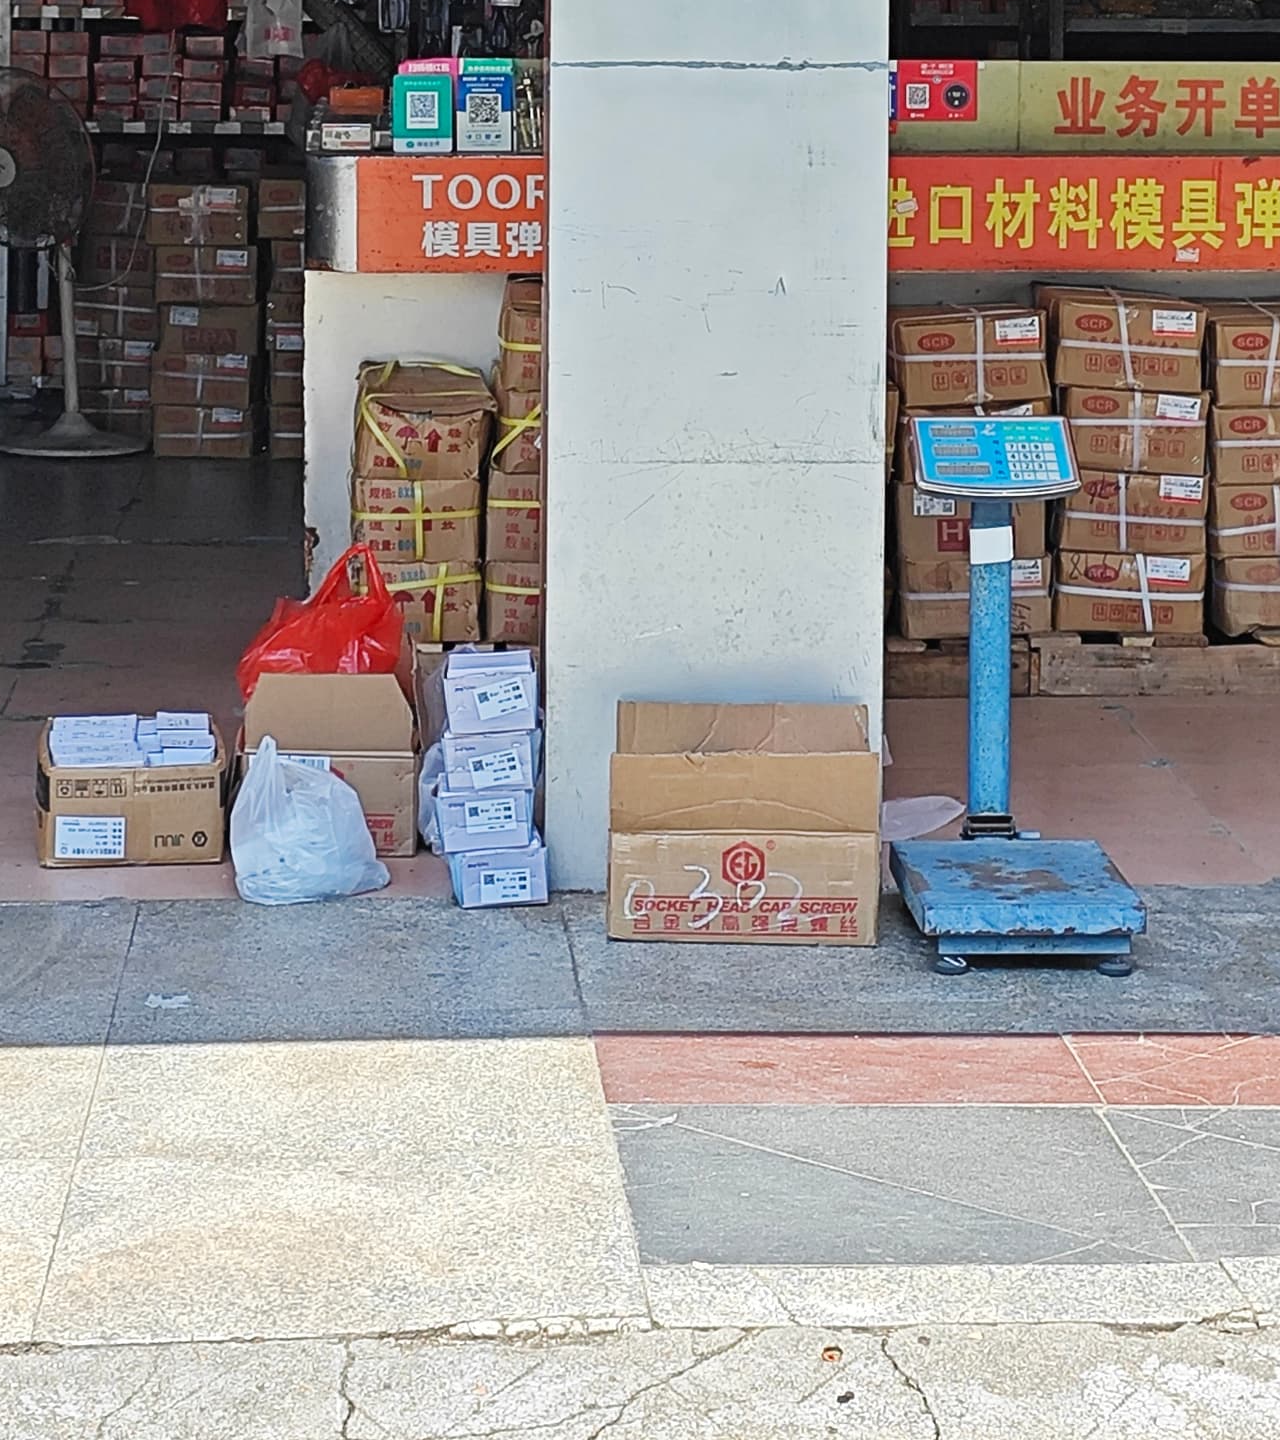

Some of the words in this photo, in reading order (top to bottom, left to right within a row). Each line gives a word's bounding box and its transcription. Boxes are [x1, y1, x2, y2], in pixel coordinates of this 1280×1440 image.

[422, 221, 542, 258] 模具弹
[1079, 319, 1108, 329] SCR
[922, 335, 951, 348] SCR
[1236, 336, 1264, 347] SCR
[1086, 400, 1114, 411] SCR
[1233, 419, 1261, 430] SCR
[1234, 498, 1262, 509] SCR
[634, 900, 701, 914] SOCKET
[800, 902, 858, 915] SCREW
